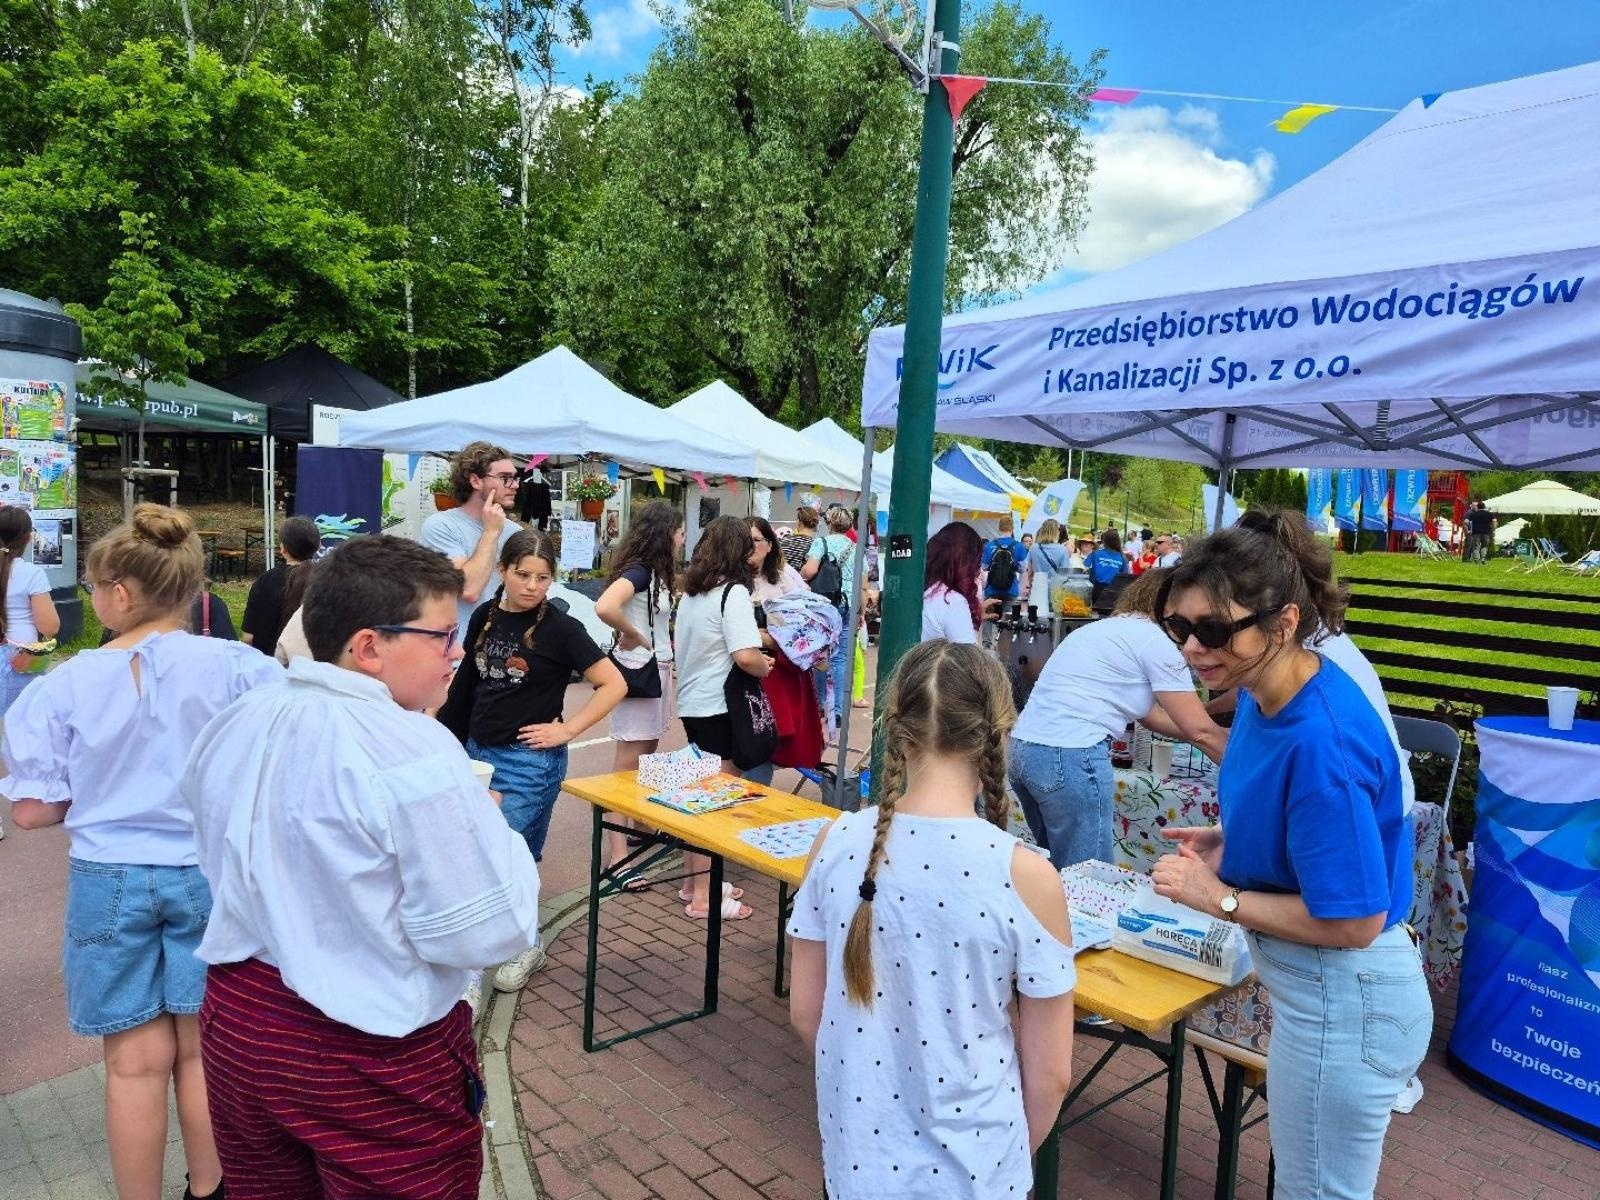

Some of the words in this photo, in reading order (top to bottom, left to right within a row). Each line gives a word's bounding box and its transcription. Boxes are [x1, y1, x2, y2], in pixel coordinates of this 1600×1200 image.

[1048, 305, 1299, 351] Przedsiębiorstwo
[1311, 272, 1585, 326] Wodociągów
[1043, 368, 1052, 394] i
[1058, 357, 1202, 393] Kanalizacji
[1208, 355, 1258, 390] Sp.
[1268, 359, 1285, 381] z
[1294, 354, 1362, 380] o.o.
[1156, 927, 1198, 948] HORECA
[1538, 961, 1569, 980] nasz
[1524, 1025, 1582, 1058] Twoje
